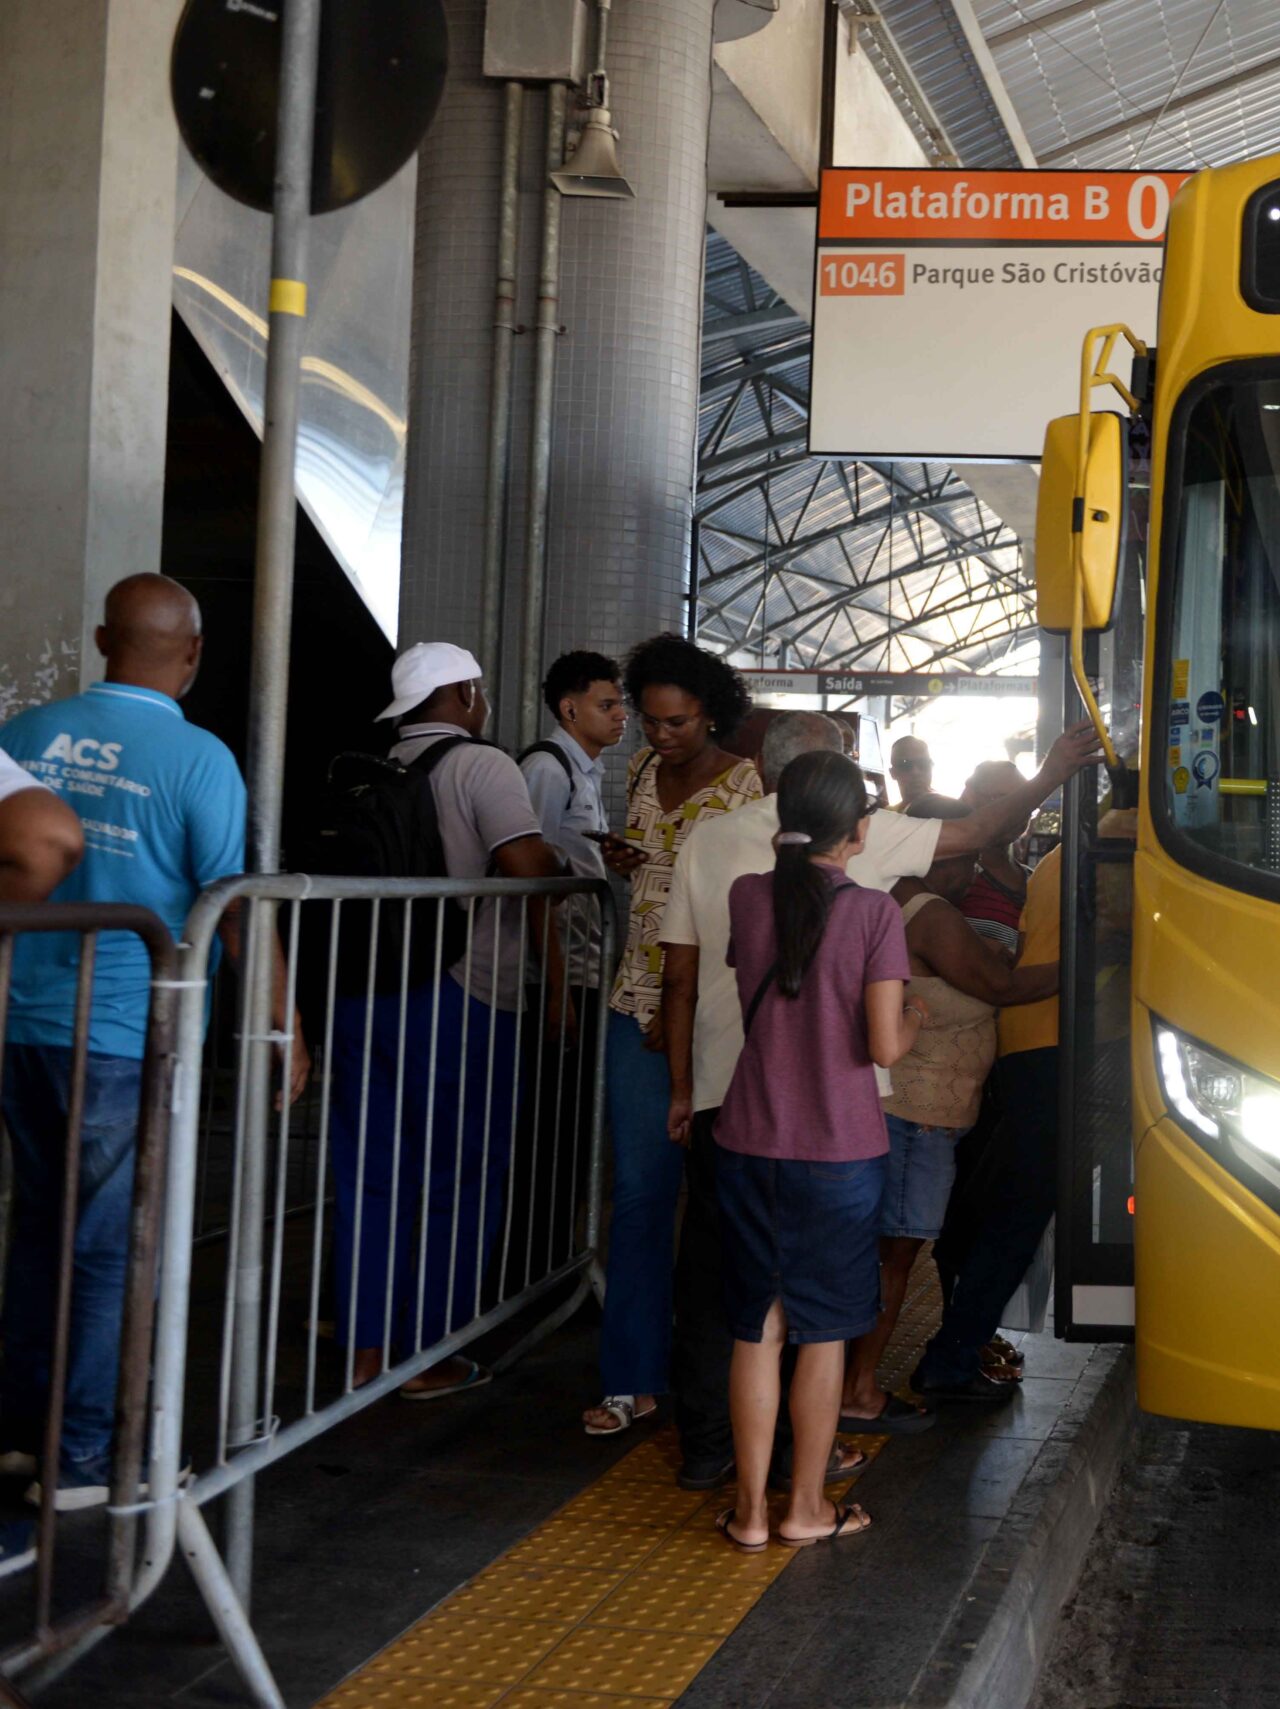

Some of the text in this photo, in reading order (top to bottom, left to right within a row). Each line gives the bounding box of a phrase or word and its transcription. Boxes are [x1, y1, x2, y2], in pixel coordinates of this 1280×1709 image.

[846, 175, 1192, 240] Plataforma B 0
[824, 261, 896, 288] 1046
[912, 264, 995, 289] Parque
[1001, 262, 1046, 284] São
[748, 677, 793, 688] taforma
[825, 677, 863, 691] Saída
[960, 679, 1031, 691] Plataformas
[41, 732, 123, 771] ACS
